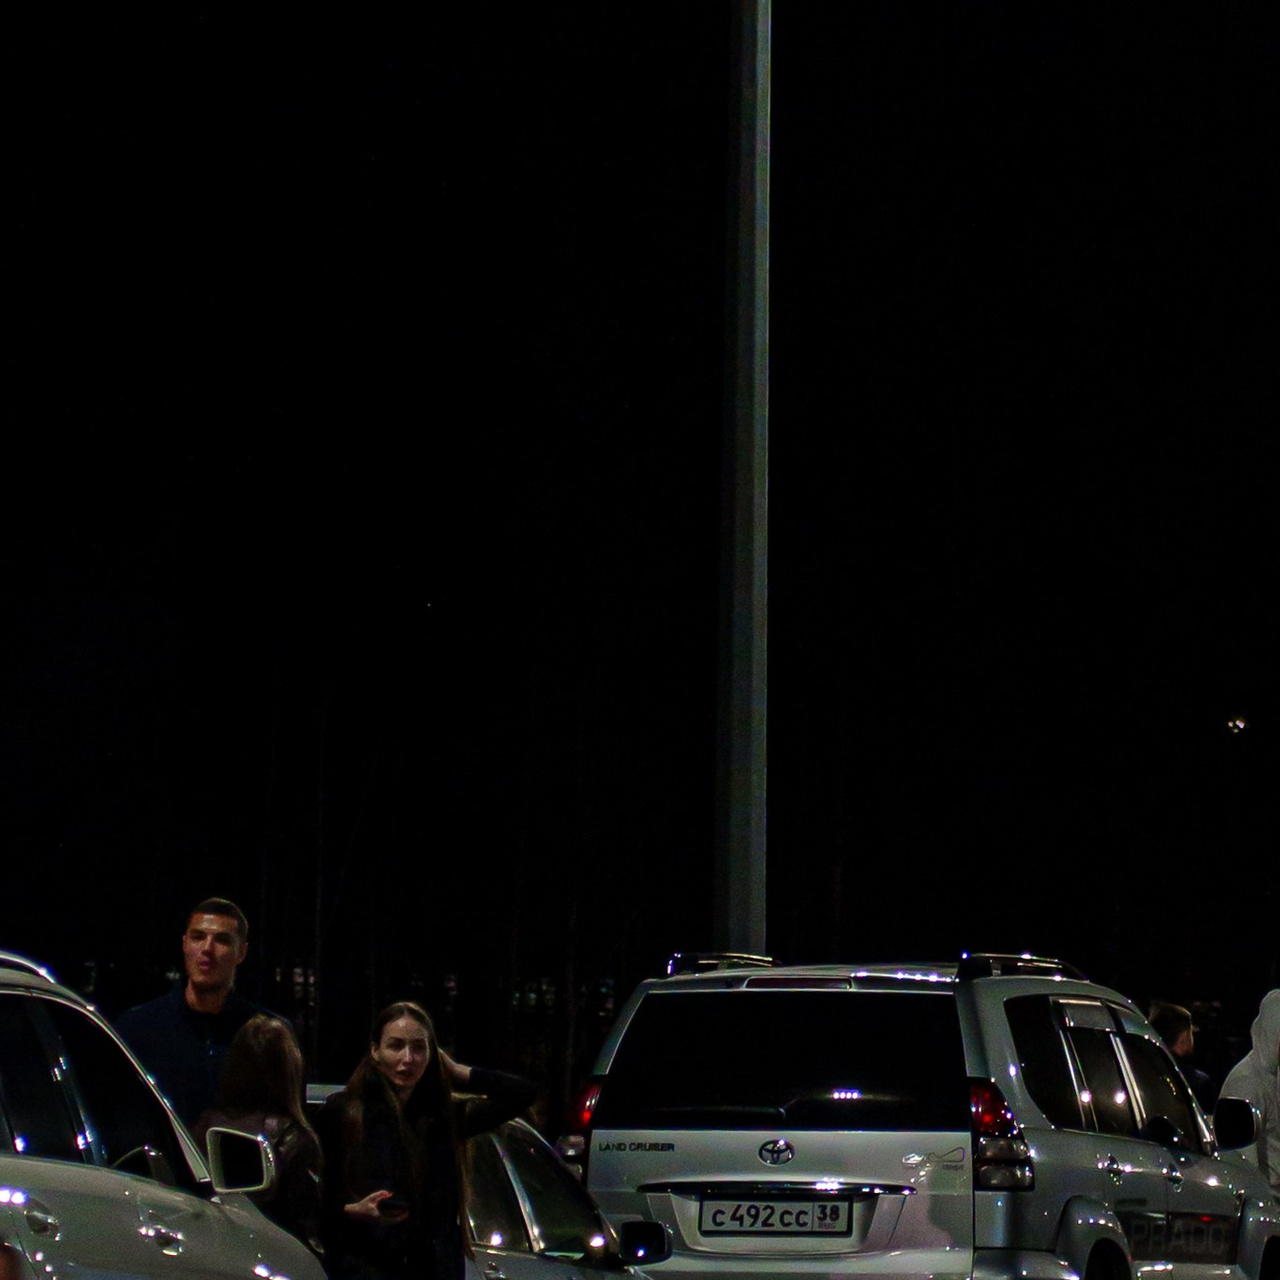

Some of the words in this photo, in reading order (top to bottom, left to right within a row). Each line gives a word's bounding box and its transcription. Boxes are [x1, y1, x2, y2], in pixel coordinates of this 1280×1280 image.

[598, 1141, 627, 1152] LAND
[628, 1141, 675, 1152] CRUISER
[817, 1204, 840, 1222] 38
